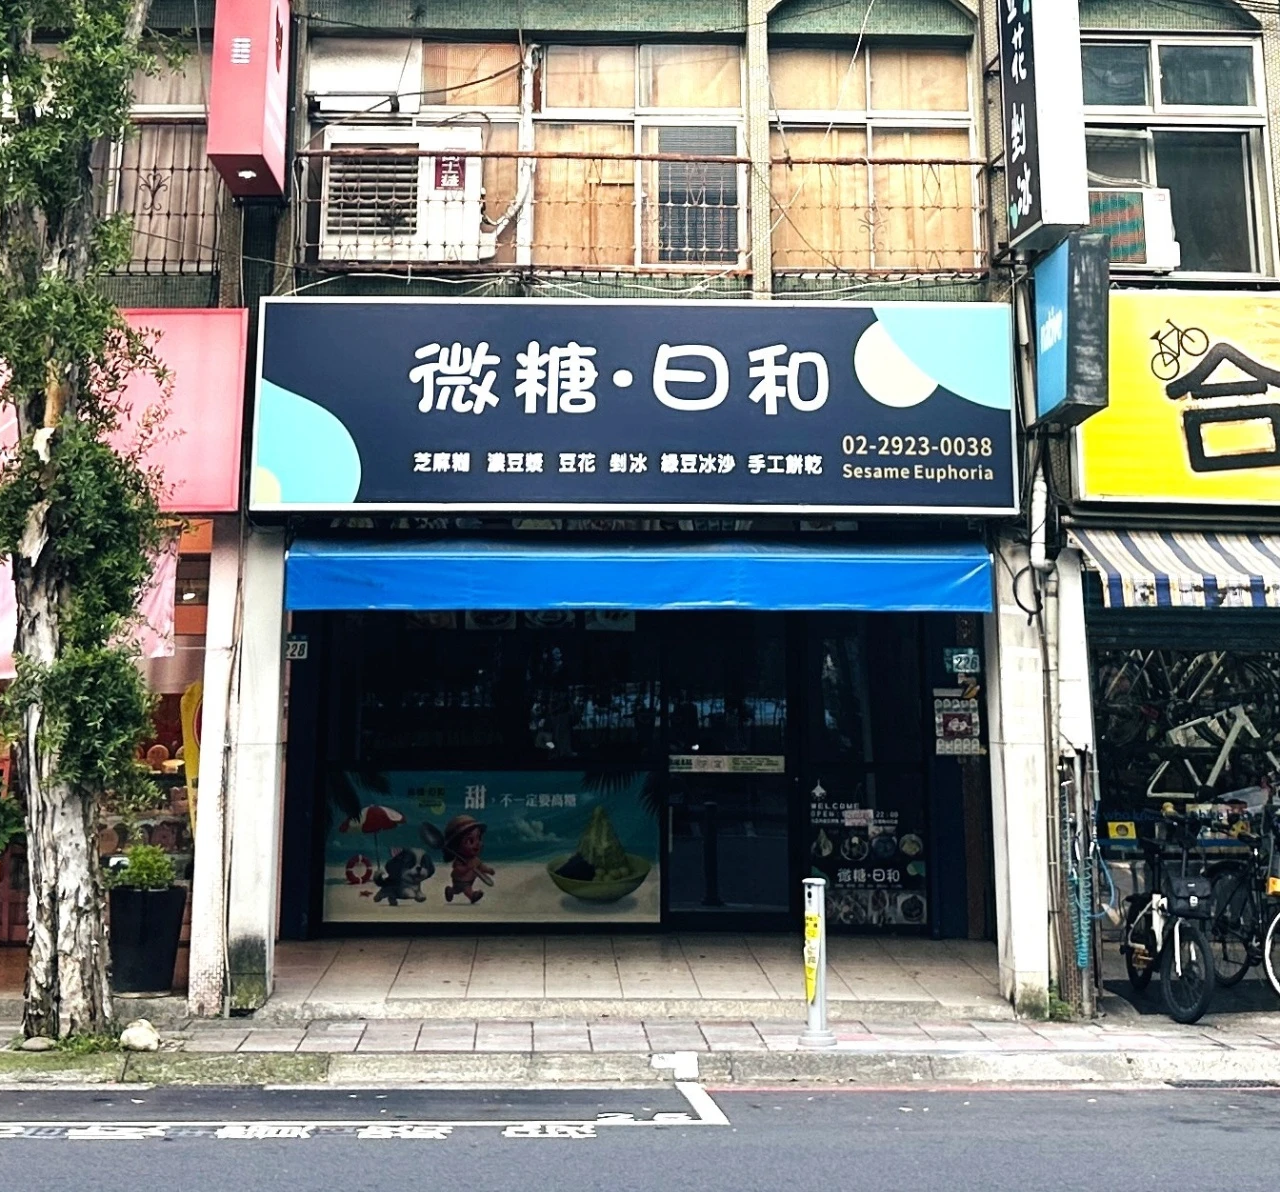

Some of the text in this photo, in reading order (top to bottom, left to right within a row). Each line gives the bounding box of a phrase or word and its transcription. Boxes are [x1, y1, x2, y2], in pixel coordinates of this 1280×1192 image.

[842, 435, 993, 456] 02-2923-0038
[413, 452, 470, 472] 芝麻糊
[559, 453, 595, 472] 豆花
[661, 453, 736, 473] 綠豆冰沙
[748, 454, 823, 475] 手工餅乾
[842, 463, 994, 483] Sesame Euphoria
[954, 655, 978, 671] 226
